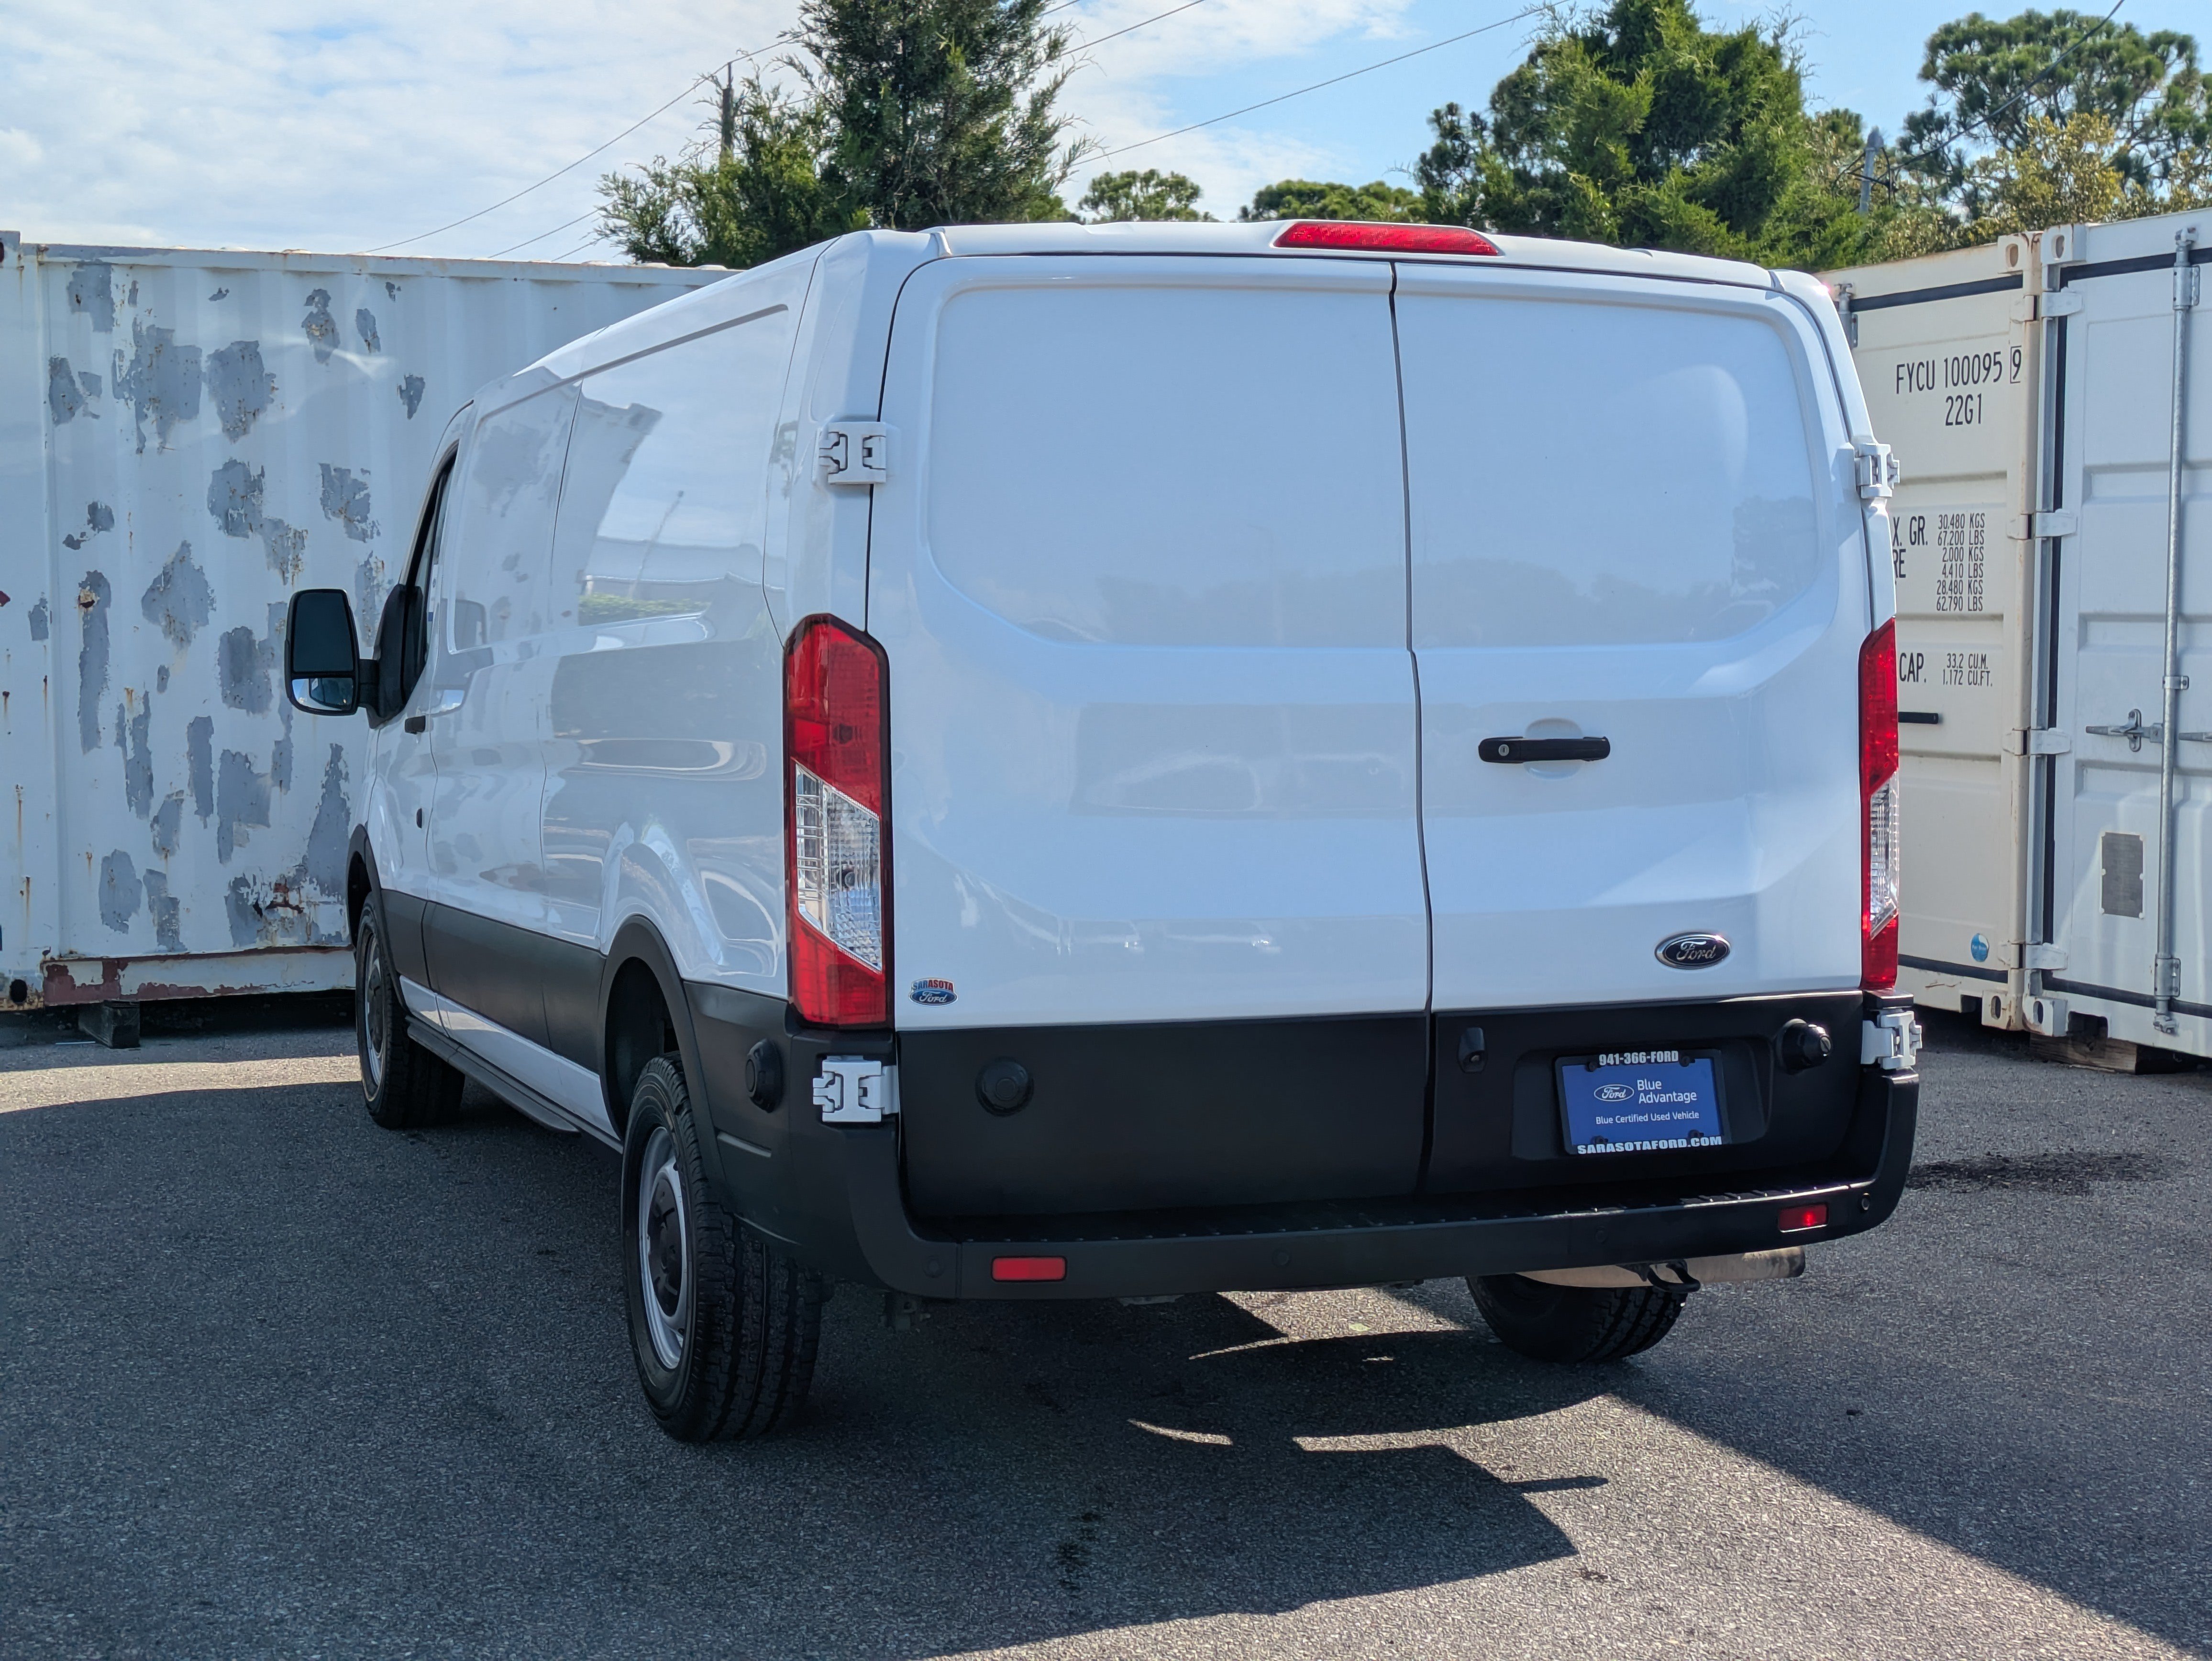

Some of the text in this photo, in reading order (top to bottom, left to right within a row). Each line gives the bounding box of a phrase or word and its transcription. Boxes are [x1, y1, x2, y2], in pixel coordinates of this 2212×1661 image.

[1896, 349, 2022, 394] FYCU 100095 9
[1945, 393, 1982, 426] 22G1
[1969, 513, 1985, 529] KGS
[1892, 515, 1928, 546] X. GR.
[1969, 530, 1984, 545] LBS
[1968, 546, 1984, 562] KGS
[1892, 548, 1906, 578] RE
[1968, 563, 1984, 578] LBS
[1968, 579, 1983, 595] KGS
[1968, 596, 1983, 611] LBS
[1899, 653, 1926, 683] CAP.
[1947, 653, 1964, 669] 33.2
[1676, 941, 1716, 961] Ford
[912, 979, 953, 992] SARASOTA
[919, 991, 948, 1003] Ford
[1599, 1050, 1679, 1066] 941-366-FORD
[1602, 1086, 1626, 1099] Ford
[1637, 1078, 1662, 1091] Blue
[1638, 1091, 1698, 1104] Advantage
[1596, 1110, 1700, 1125] Blue Certified Used Vehicle
[1577, 1136, 1723, 1154] SARASOTAFORD.COM
